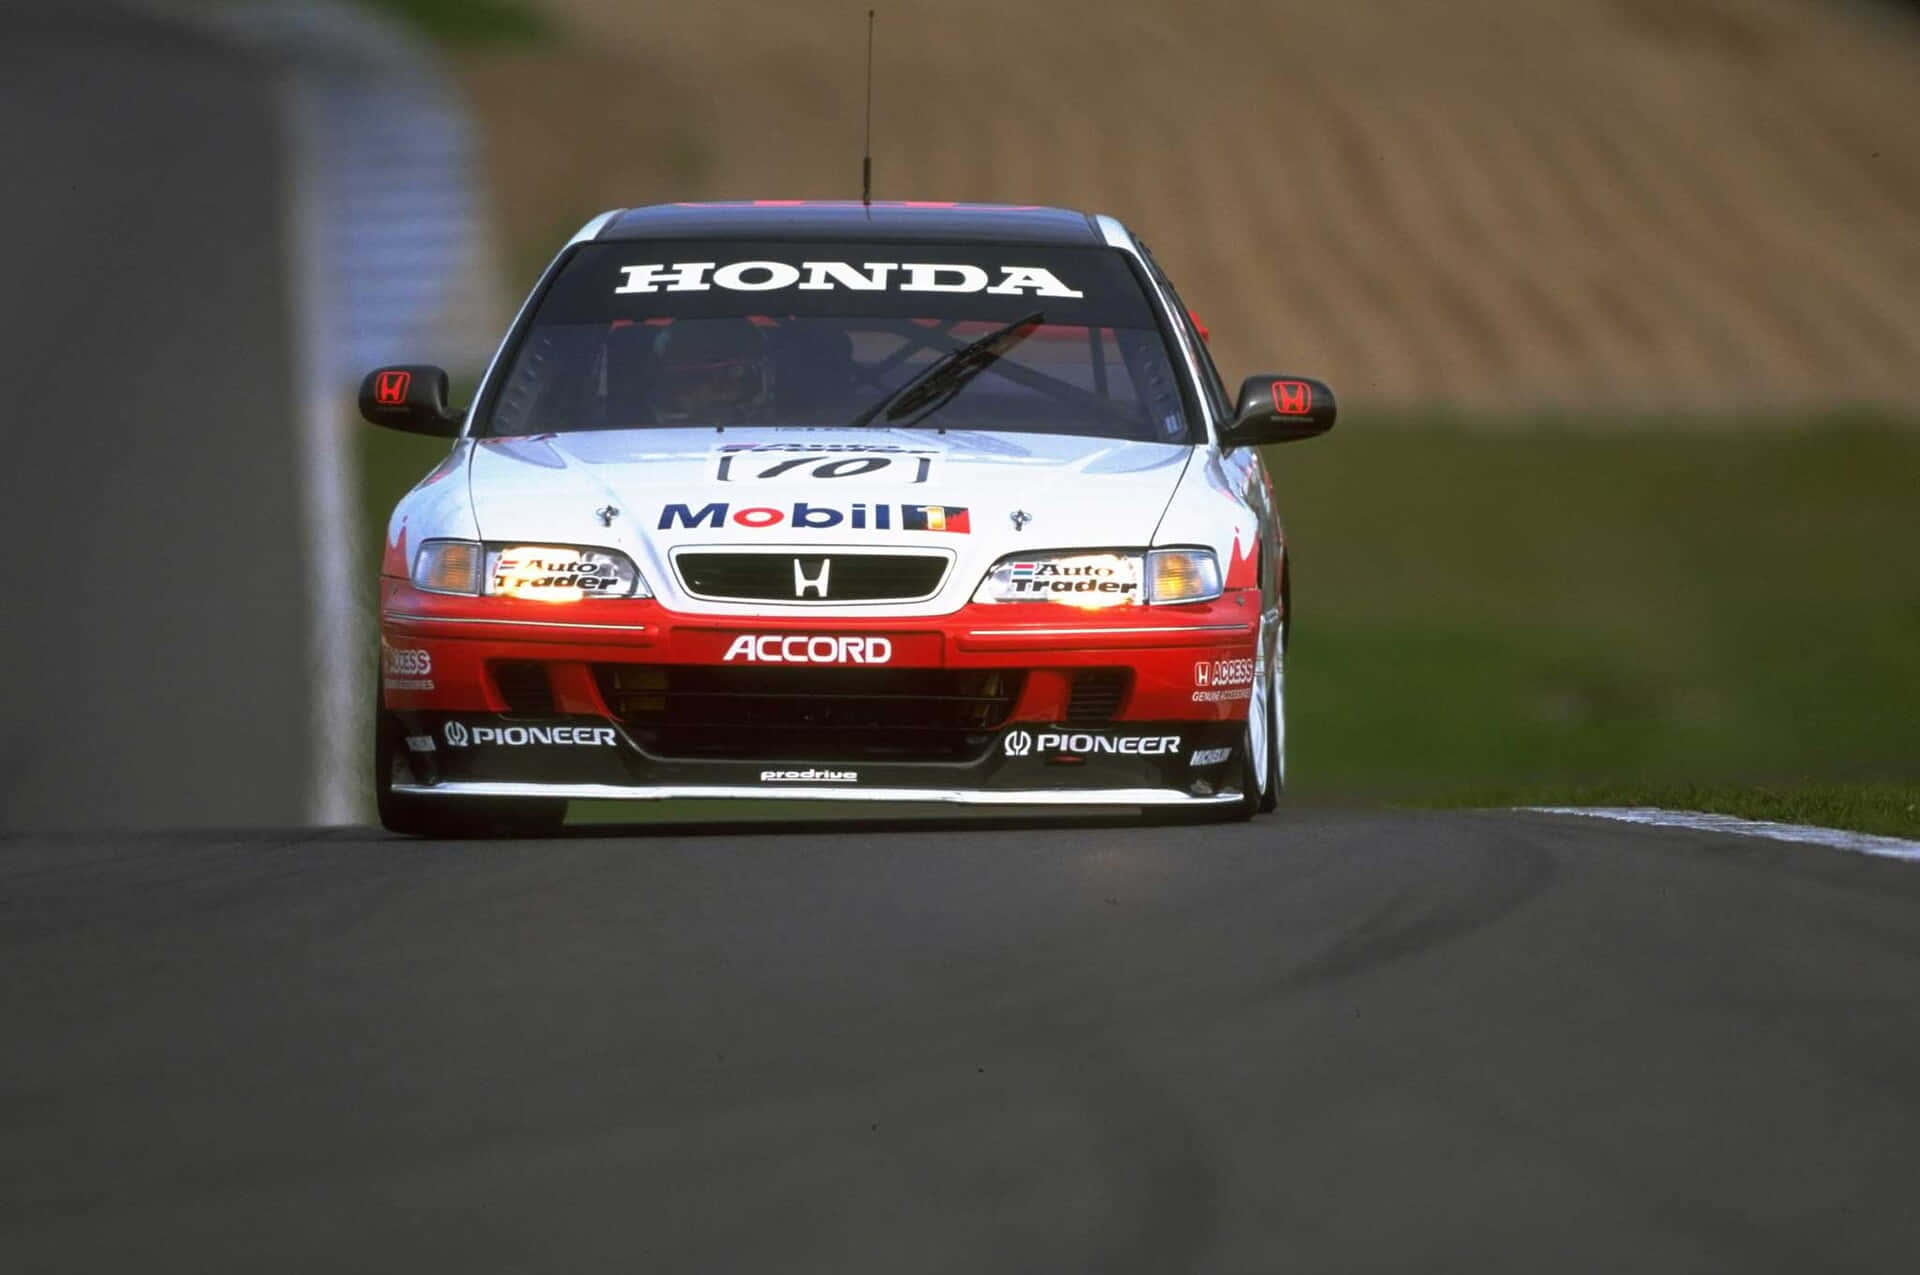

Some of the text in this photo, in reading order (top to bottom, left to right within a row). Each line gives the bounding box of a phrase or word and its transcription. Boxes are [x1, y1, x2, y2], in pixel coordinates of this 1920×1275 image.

[615, 261, 1084, 299] HONDA
[757, 455, 892, 479] 10
[657, 502, 891, 531] Mobil
[525, 559, 598, 573] Auto
[1034, 563, 1115, 576] Auto
[495, 574, 619, 590] Trader
[1011, 578, 1138, 594] Trader
[722, 635, 892, 664] ACCORD
[1212, 658, 1254, 686] ACCESS
[472, 726, 617, 746] PIONEER
[1036, 733, 1181, 754] PIONEER
[760, 768, 858, 782] prodrive
